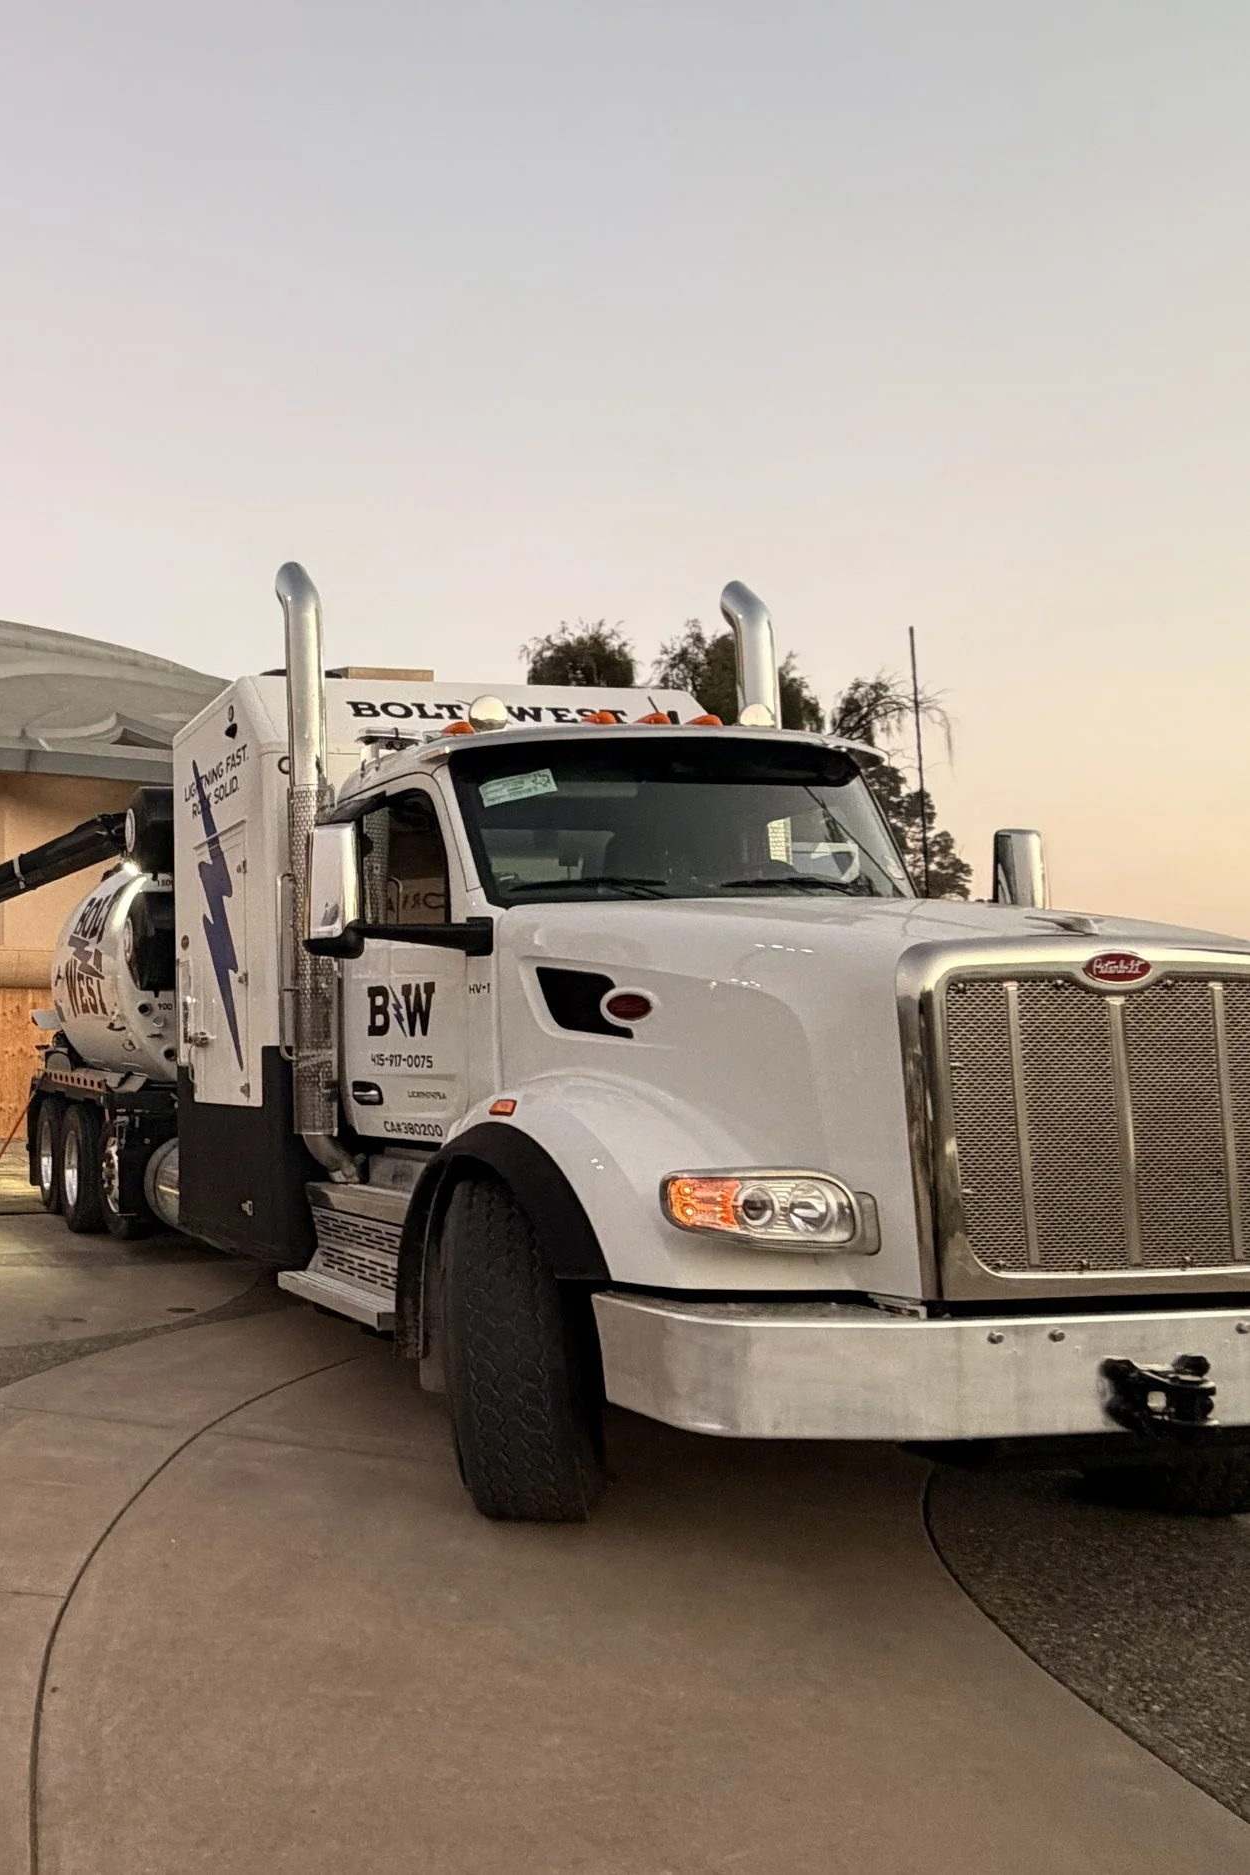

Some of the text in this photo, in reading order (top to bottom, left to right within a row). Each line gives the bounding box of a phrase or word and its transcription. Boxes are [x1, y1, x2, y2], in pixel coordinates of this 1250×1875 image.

[347, 700, 628, 724] BOLT WEST
[184, 761, 225, 803] LIGNING
[225, 744, 249, 773] FAST.
[213, 775, 240, 805] SOLID.
[370, 1053, 433, 1069] 415-917-0075
